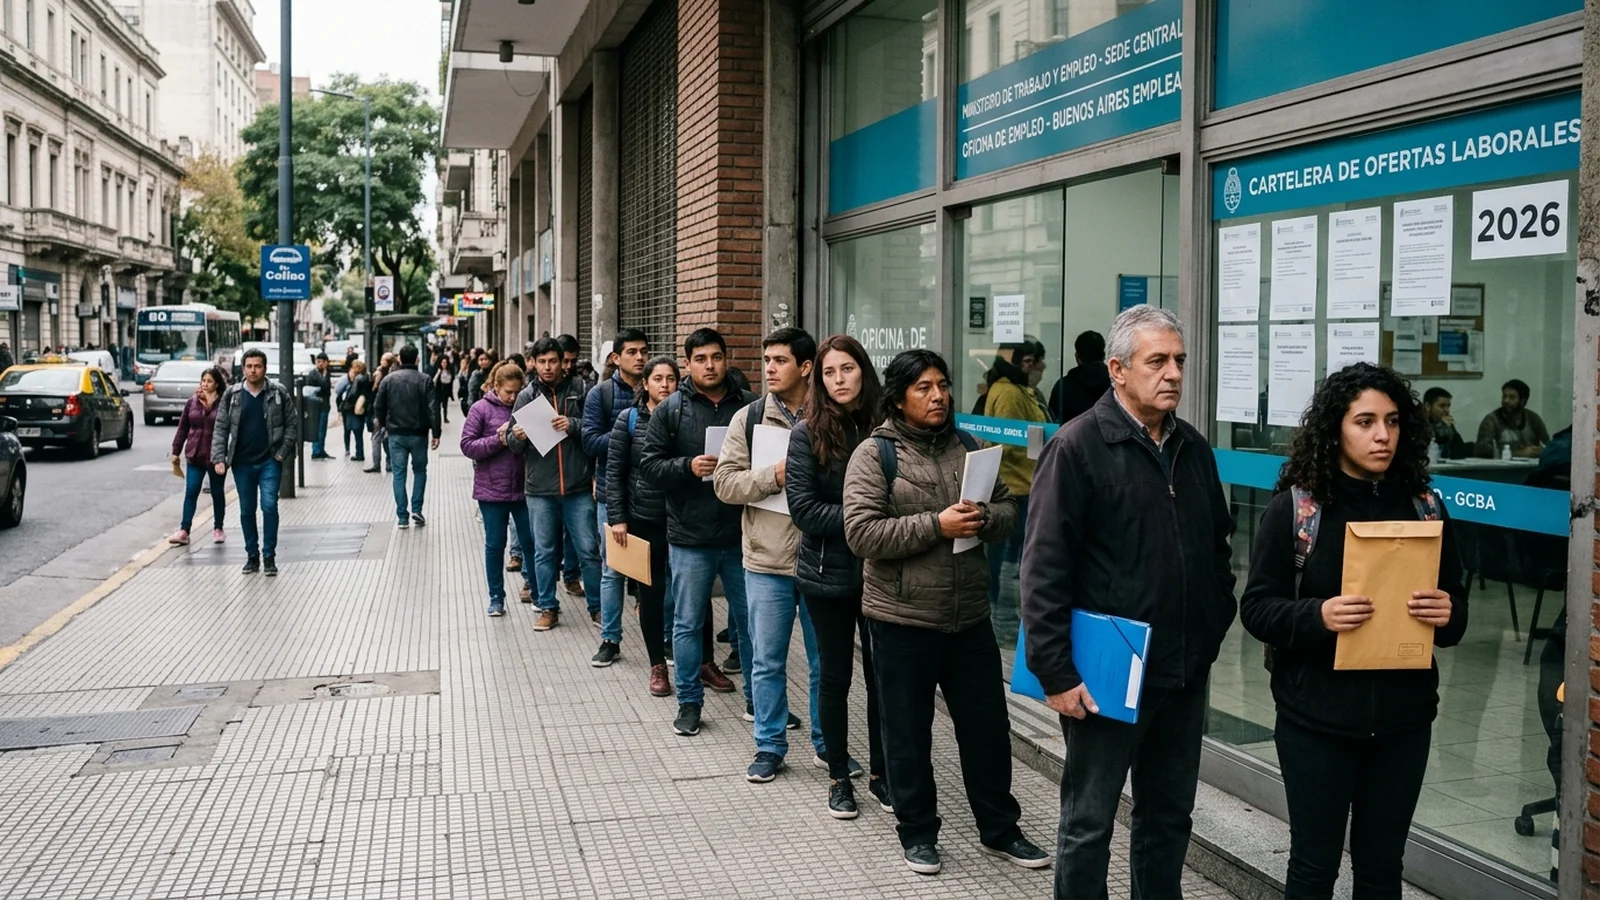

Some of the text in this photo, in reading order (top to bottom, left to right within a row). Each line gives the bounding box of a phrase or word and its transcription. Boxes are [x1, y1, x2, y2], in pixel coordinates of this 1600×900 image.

[1002, 86, 1013, 104] DE
[1014, 71, 1051, 99] TRABAJO
[1052, 68, 1059, 85] Y
[1060, 53, 1097, 81] EMPLEO
[1105, 39, 1130, 66] SEDE
[1133, 18, 1183, 55] CENTRAL
[995, 129, 1007, 149] DE
[1008, 116, 1045, 144] EMPLEO
[1052, 100, 1094, 131] BUENOS
[1096, 87, 1130, 117] AIRES
[1133, 71, 1183, 105] EMPLEA
[1249, 118, 1582, 196] CARTELERA DE OFERTAS LABORALES
[1477, 201, 1561, 243] 2026
[861, 326, 927, 350] OFICINA DE
[1455, 491, 1496, 511] GCBA
